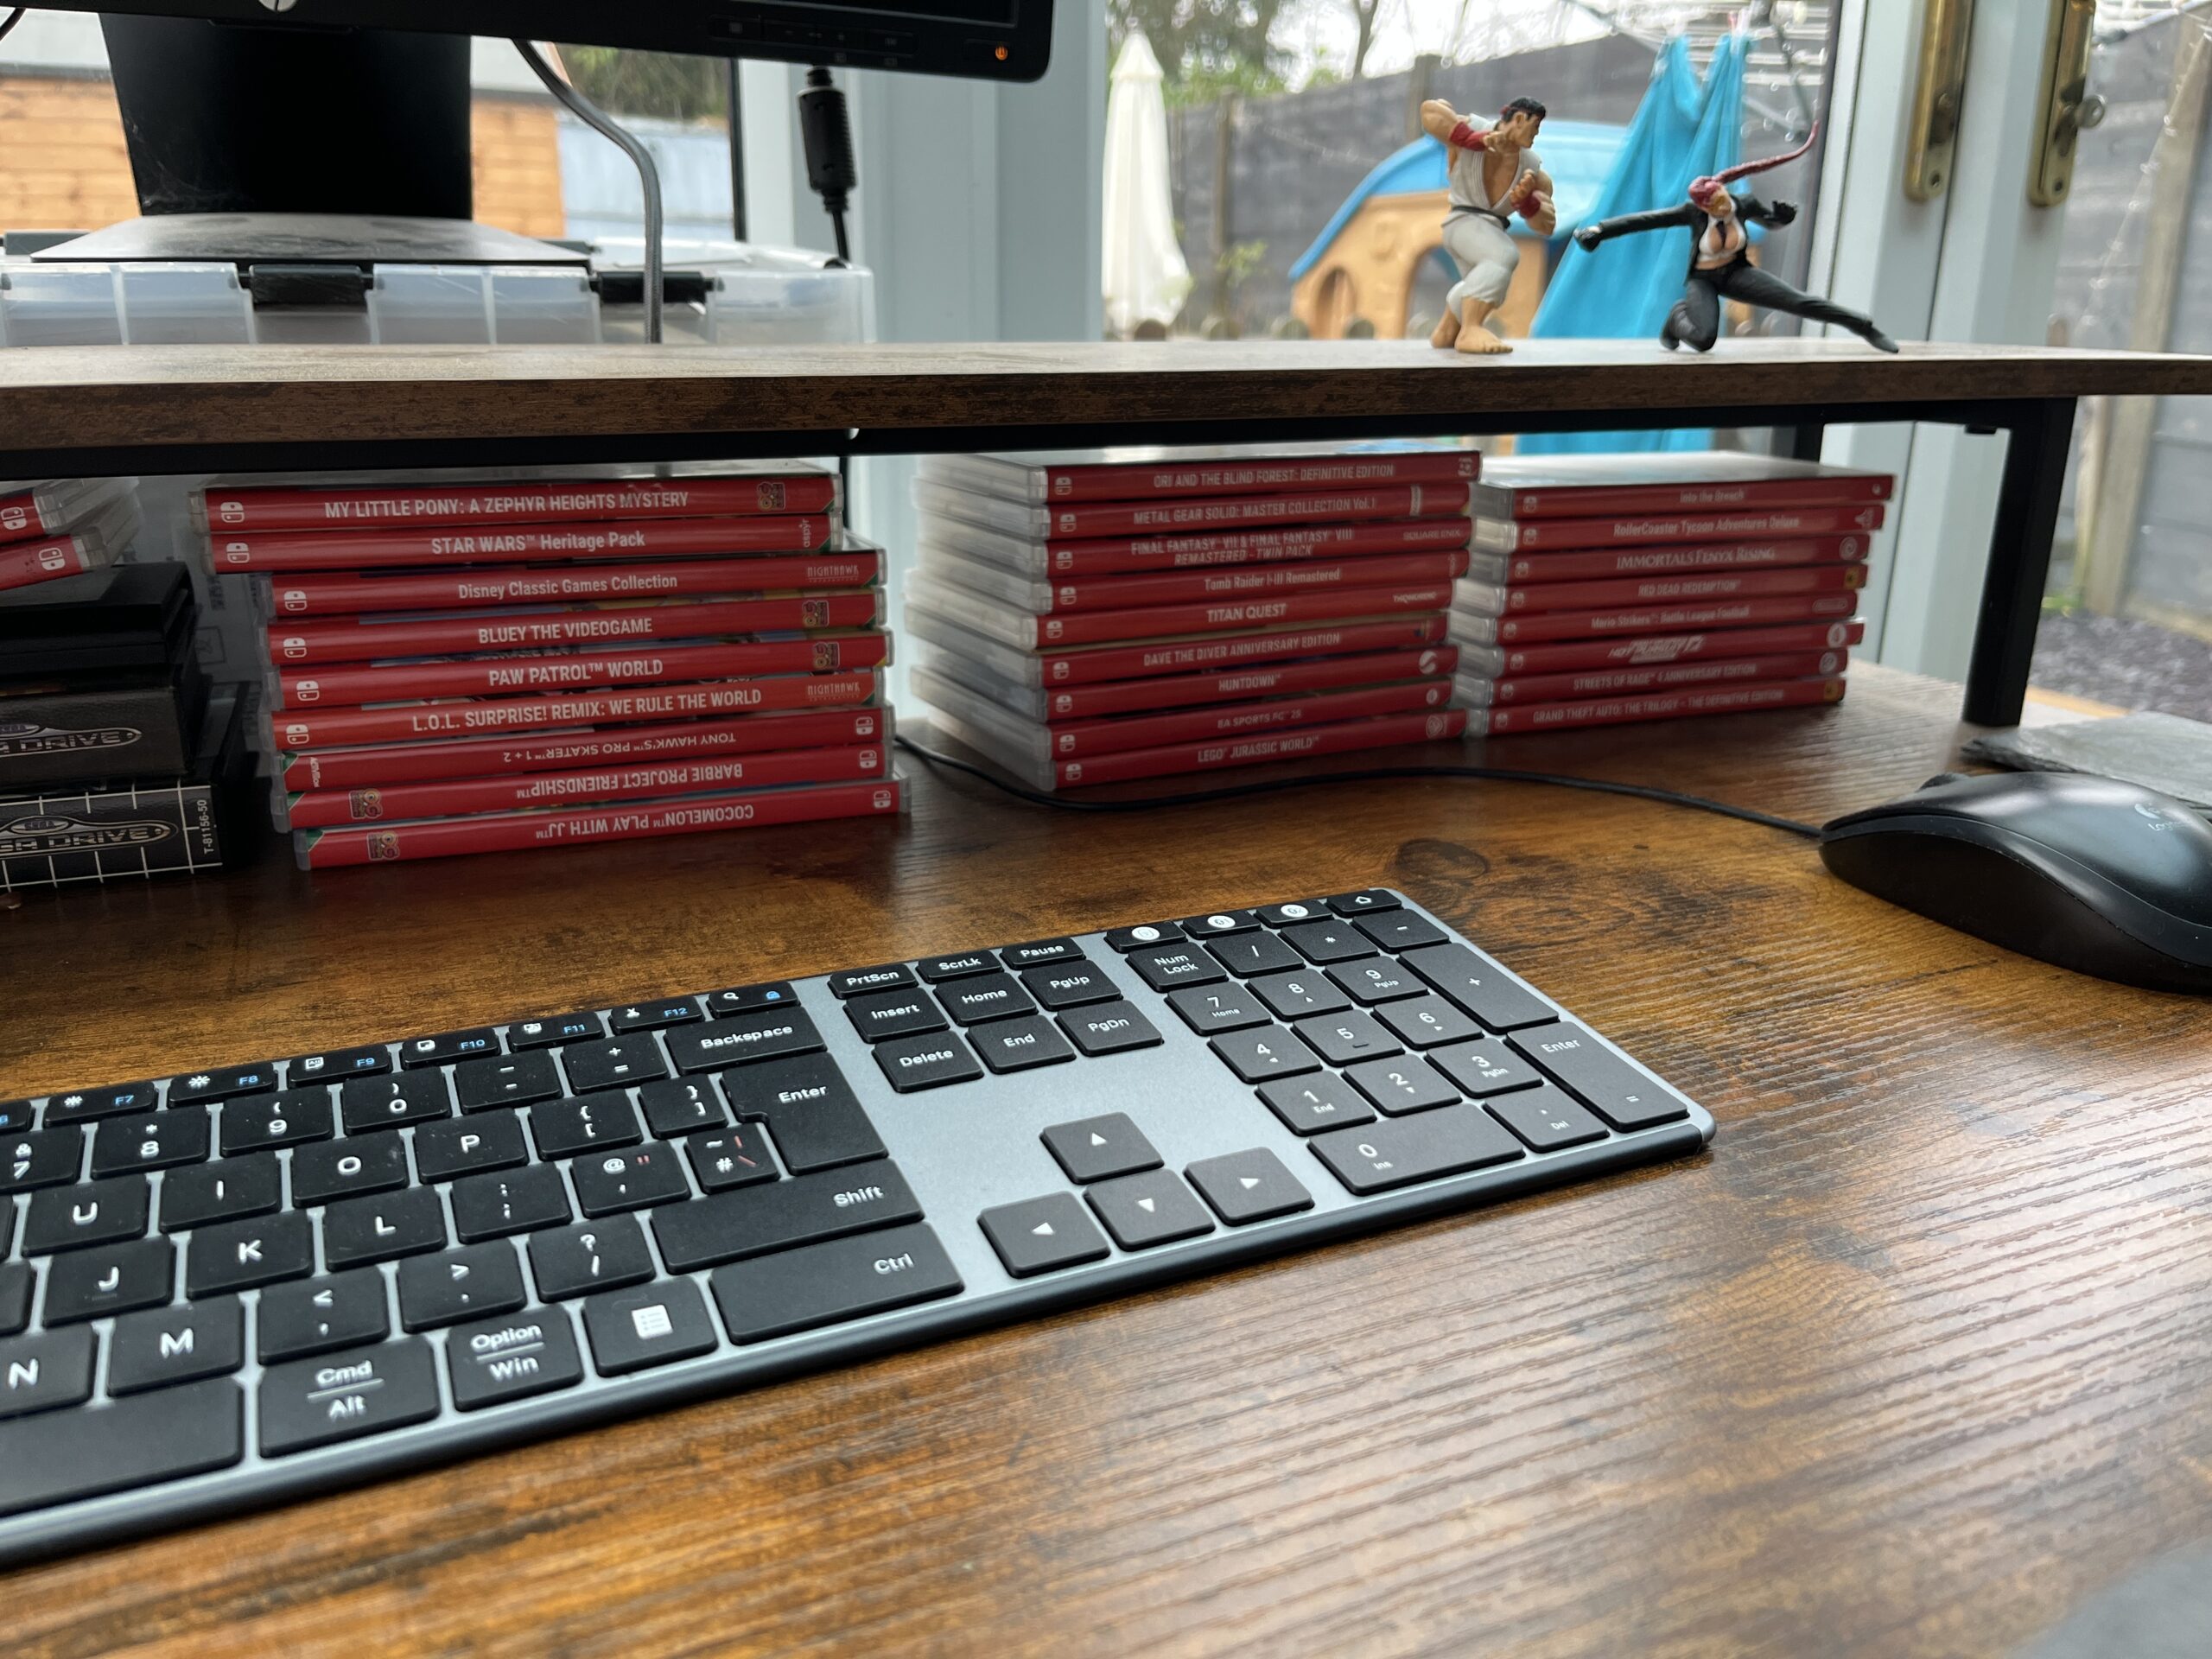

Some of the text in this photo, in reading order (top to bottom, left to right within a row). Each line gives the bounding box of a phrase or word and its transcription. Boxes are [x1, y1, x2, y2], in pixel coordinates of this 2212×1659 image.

[1175, 474, 1197, 486] AND
[1201, 473, 1222, 485] THE
[1224, 472, 1253, 484] BLIND
[1356, 465, 1395, 478] EDITION
[325, 491, 690, 518] MY LITTLE PONY: A ZEPHYR HEIGHTS MYSTERY
[1134, 510, 1170, 524] METAL
[1173, 508, 1203, 522] GEAR
[1205, 505, 1240, 520] SOLID:
[1243, 503, 1286, 518] MASTER
[1288, 499, 1351, 515] COLLECTION
[432, 537, 475, 554] STAR
[540, 533, 605, 553] Heritage
[608, 531, 645, 548] Pack
[1131, 540, 1164, 555] FINAL
[1249, 533, 1281, 546] FINAL
[1173, 543, 1314, 566] REMASTERED TWIN PACK
[458, 575, 677, 601] Disney Classic Games Collection
[1205, 568, 1341, 591] Tomb Raider Remastered
[1206, 602, 1287, 622] TITAN QUEST
[478, 618, 652, 644] BLUEY THE VIDEOGAME
[1143, 632, 1340, 667] DAVE THE DIVER ANNIVERSARY EDITION
[488, 669, 524, 686] PAW
[607, 659, 664, 678] WORLD
[413, 689, 761, 732] L.O.L. SURPRISE! REMIX: WE RULE THE WORLD
[1233, 713, 1270, 728] SPORTS
[603, 741, 630, 753] PRO
[701, 732, 736, 745] TONY
[1230, 741, 1277, 758] JURASSIC
[624, 768, 688, 787] PROJECT
[692, 763, 742, 779] BARBIE
[196, 799, 215, 855] T-81156-50
[570, 819, 609, 836] WITH
[613, 814, 649, 832] PLAY
[1020, 944, 1065, 957] Pause
[1154, 953, 1189, 967] Num
[938, 957, 982, 970] ScrLk
[1164, 961, 1199, 975] Lock
[845, 970, 900, 988] PrtScn
[1050, 975, 1090, 990] PgUp
[1374, 977, 1400, 989] PgUp
[961, 988, 1008, 1005] Home
[664, 1006, 688, 1018] F12
[870, 1004, 920, 1020] Insert
[1211, 1007, 1241, 1019] Home
[563, 1022, 586, 1034] F11
[1088, 1017, 1130, 1033] PgDn
[459, 1039, 486, 1051] F10
[700, 1024, 794, 1050] Backspace
[1003, 1033, 1036, 1048] End
[1541, 1036, 1581, 1055] Enter
[356, 1057, 376, 1069] F9
[899, 1048, 954, 1068] Delete
[238, 1074, 258, 1086] F8
[115, 1094, 135, 1106] F7
[777, 1084, 828, 1104] Enter
[1313, 1101, 1335, 1114] End
[1549, 1119, 1570, 1131] Del
[460, 1134, 480, 1154] P
[1372, 1157, 1394, 1171] Ins
[832, 1185, 885, 1208] Shift
[72, 1200, 99, 1226] U
[375, 1216, 397, 1236] L
[237, 1239, 263, 1264] K
[873, 1251, 915, 1276] Ctrl
[98, 1265, 120, 1292] J
[160, 1328, 194, 1358] M
[469, 1321, 543, 1351] Option
[8, 1357, 40, 1389] N
[315, 1359, 374, 1389] Cmd
[489, 1355, 538, 1380] Win
[327, 1394, 367, 1420] Alt
